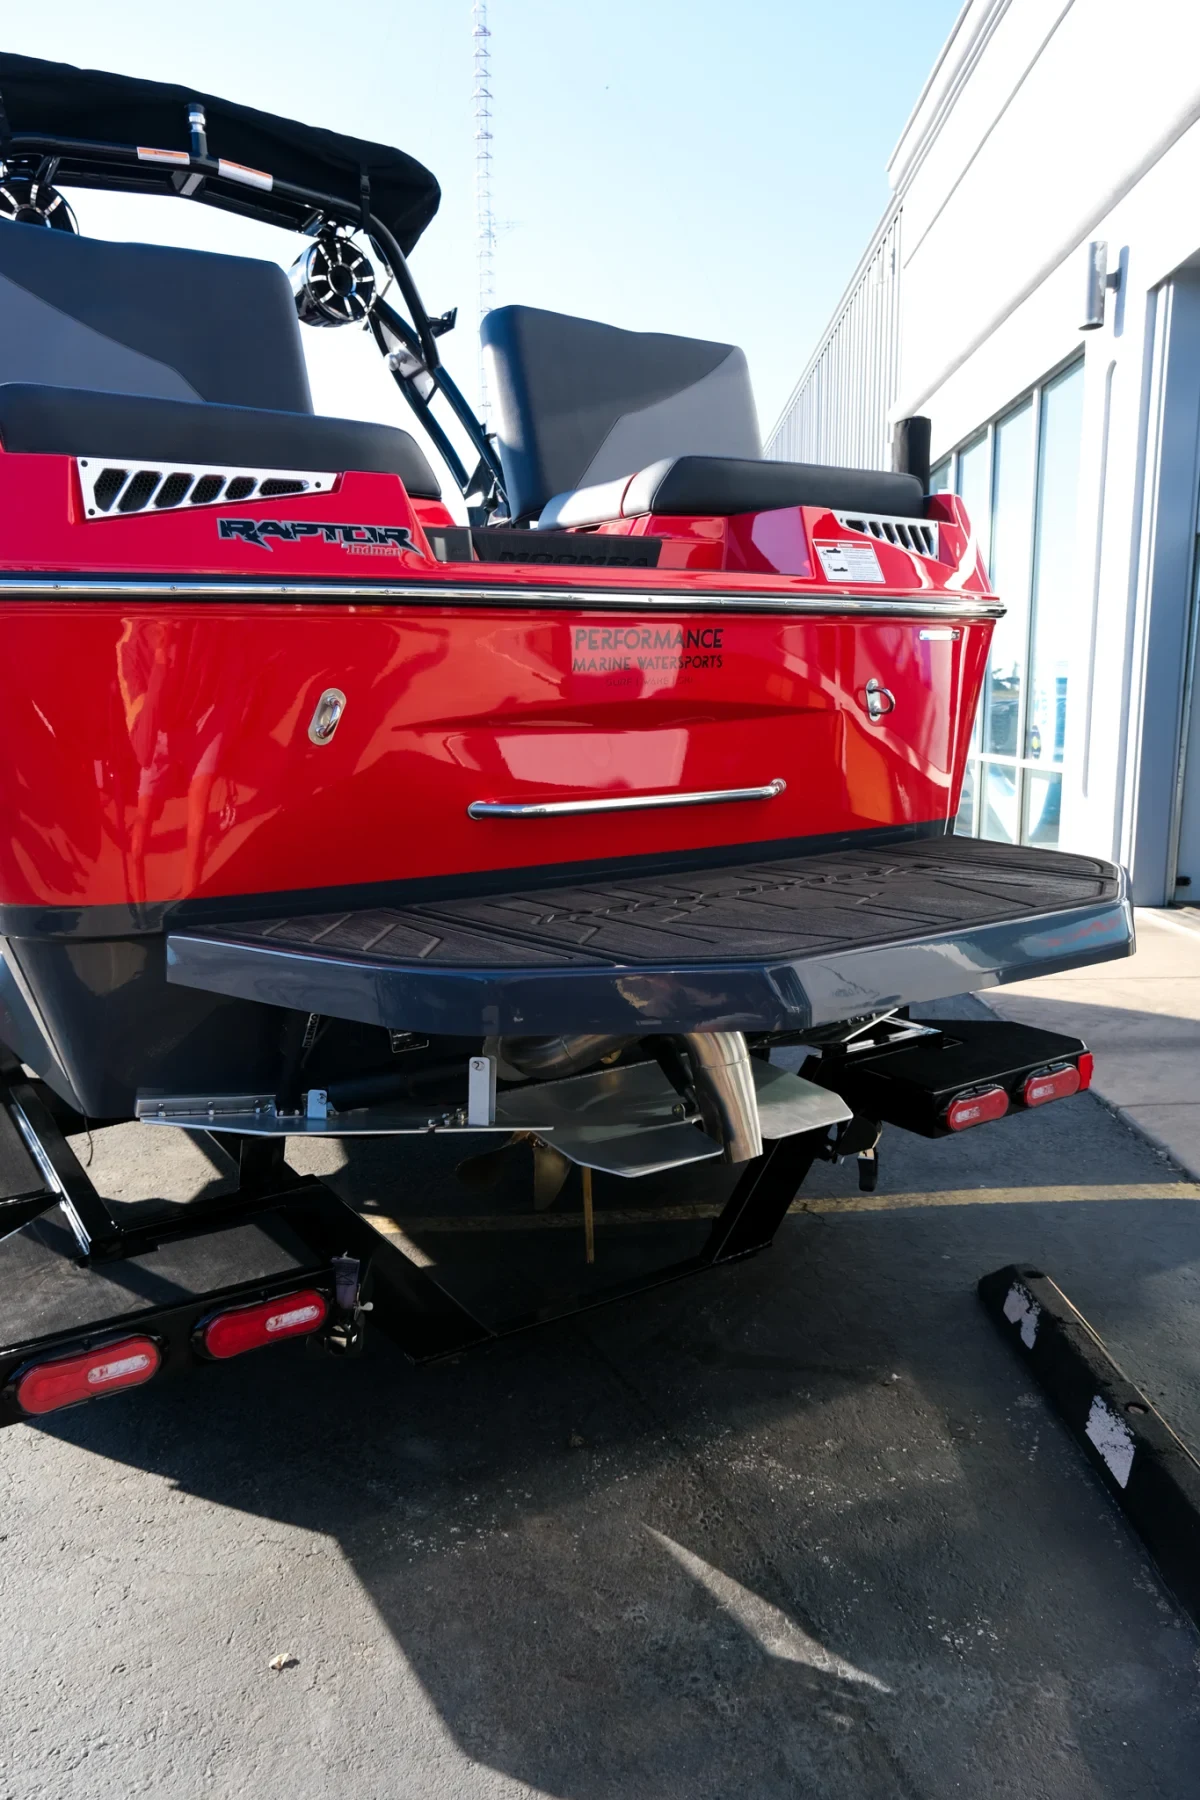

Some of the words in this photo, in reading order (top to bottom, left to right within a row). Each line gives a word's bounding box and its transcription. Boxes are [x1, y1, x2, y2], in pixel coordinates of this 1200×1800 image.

[217, 518, 425, 559] RAPTOR
[575, 628, 724, 650] PERFORMANCE
[572, 656, 631, 672] MARINE
[637, 654, 723, 670] WATERSPORTS
